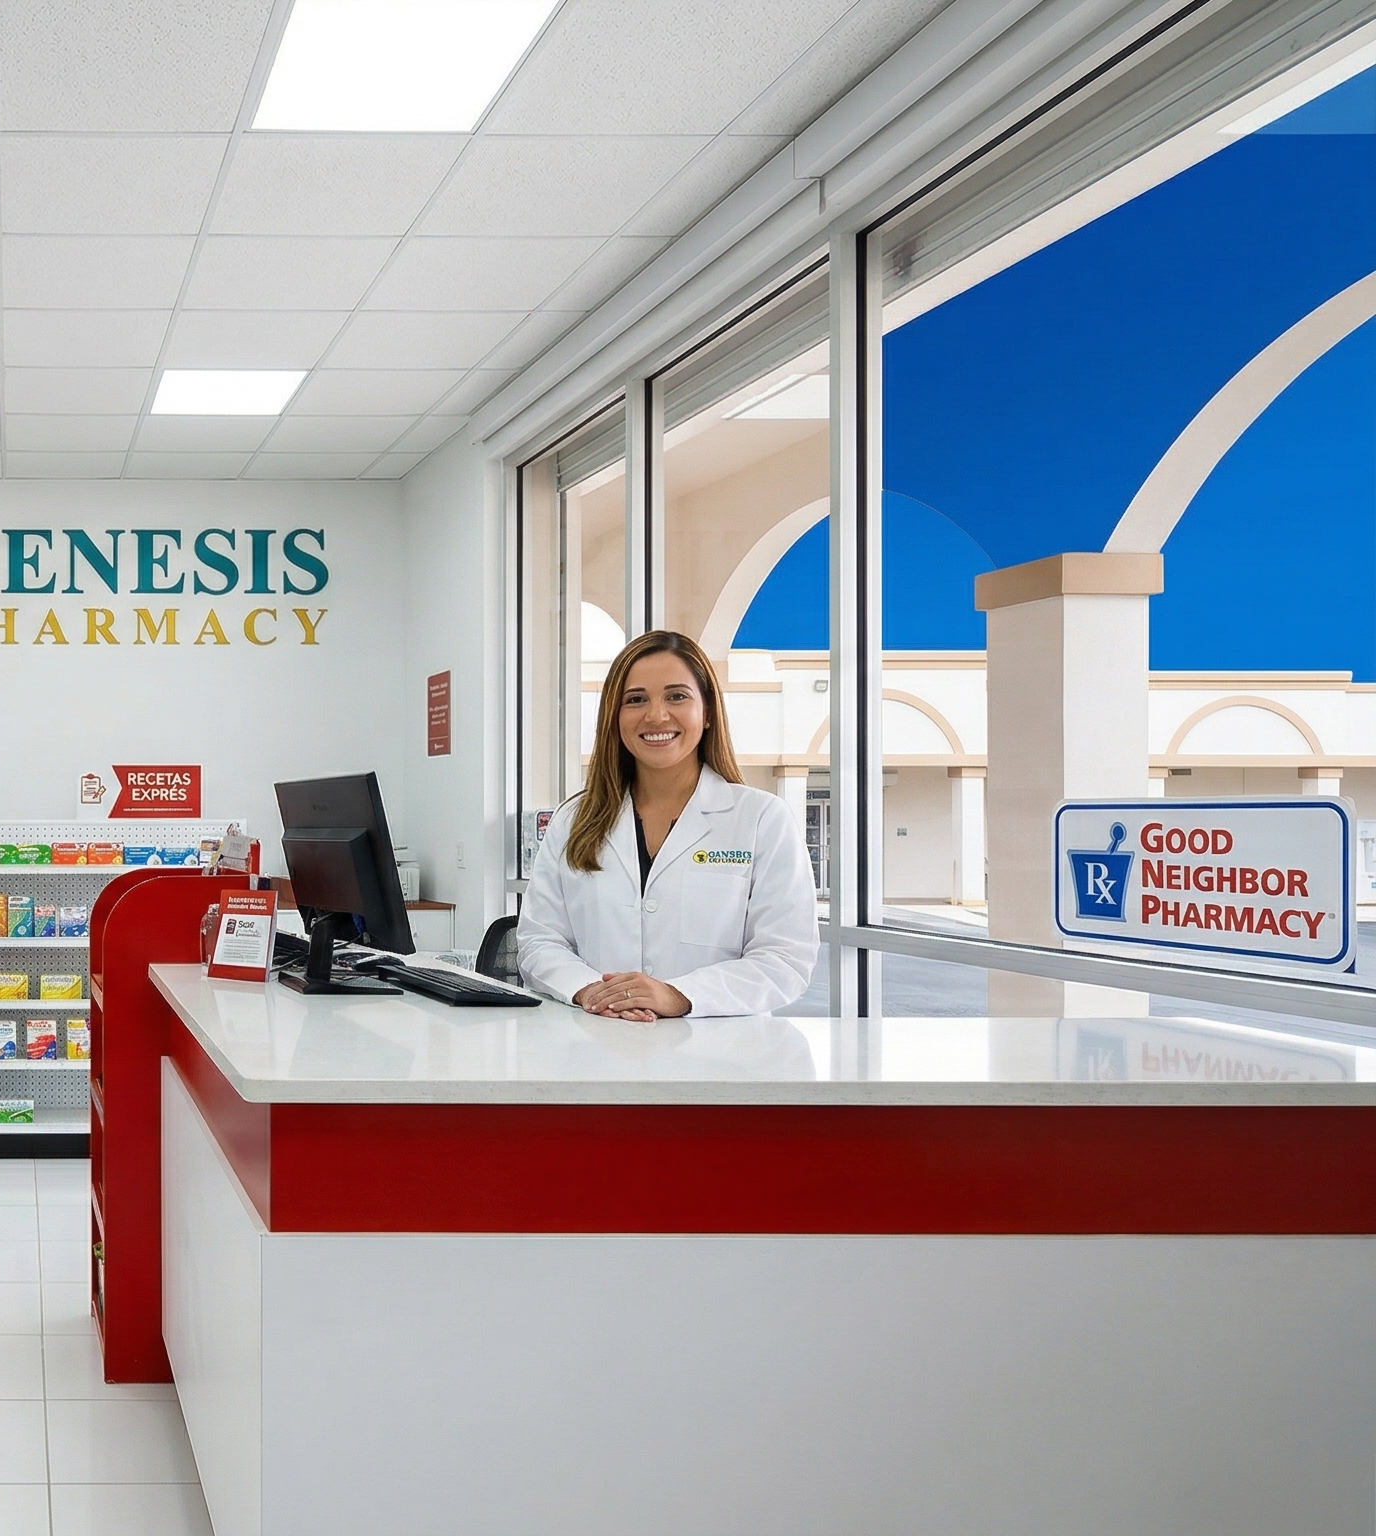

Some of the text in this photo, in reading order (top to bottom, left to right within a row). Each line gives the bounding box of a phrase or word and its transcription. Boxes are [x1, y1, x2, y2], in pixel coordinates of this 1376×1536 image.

[127, 772, 191, 786] RECETAS
[132, 785, 187, 801] EXPRÉS
[1140, 822, 1233, 855] GOOD
[1141, 859, 1309, 898] NEIGHBOR
